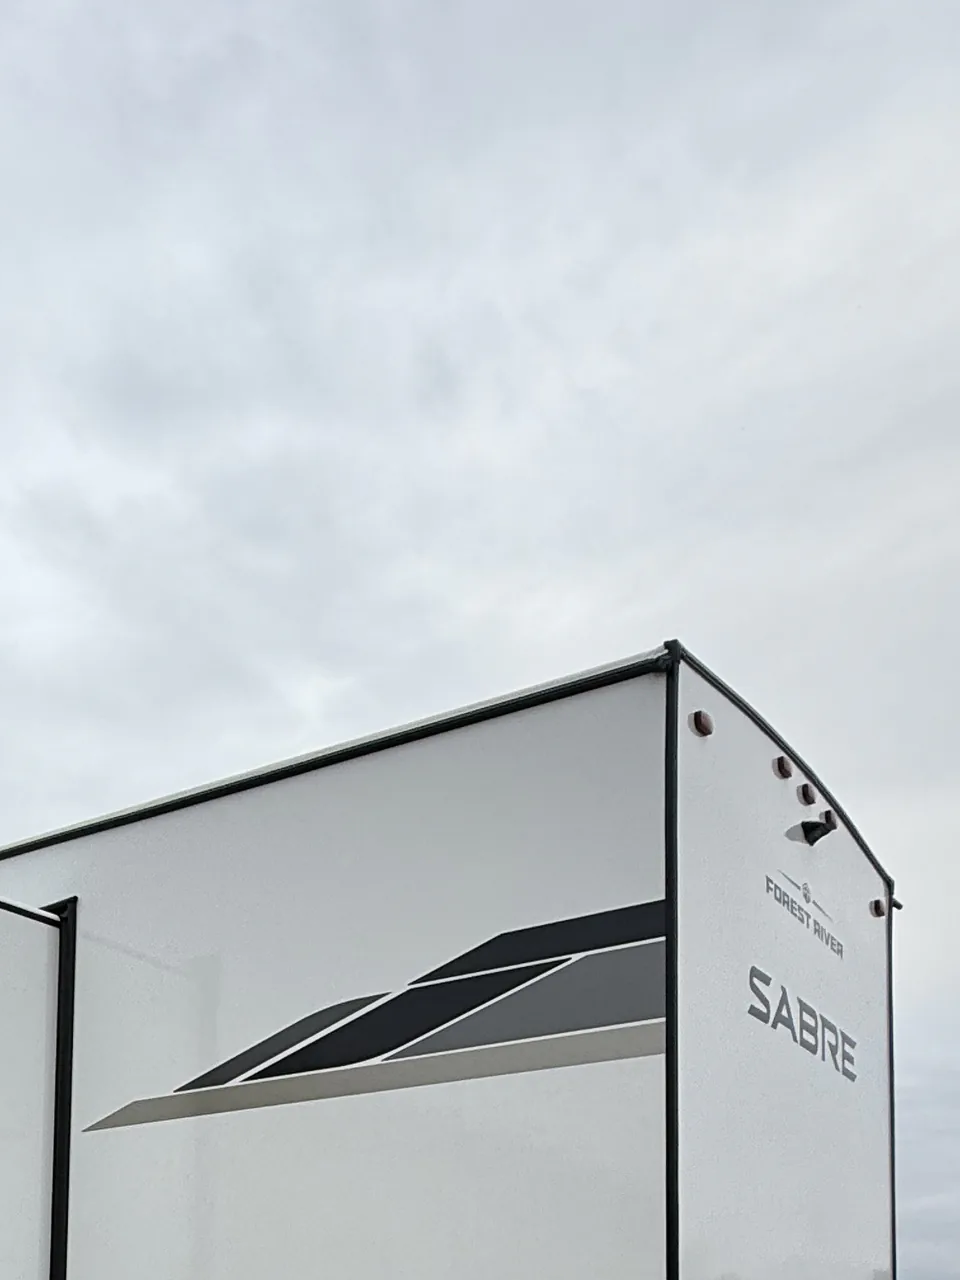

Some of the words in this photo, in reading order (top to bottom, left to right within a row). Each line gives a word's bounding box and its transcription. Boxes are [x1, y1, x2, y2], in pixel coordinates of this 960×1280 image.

[765, 875, 812, 929] FOREST
[813, 918, 844, 960] RIVER
[747, 965, 858, 1083] SABRE
